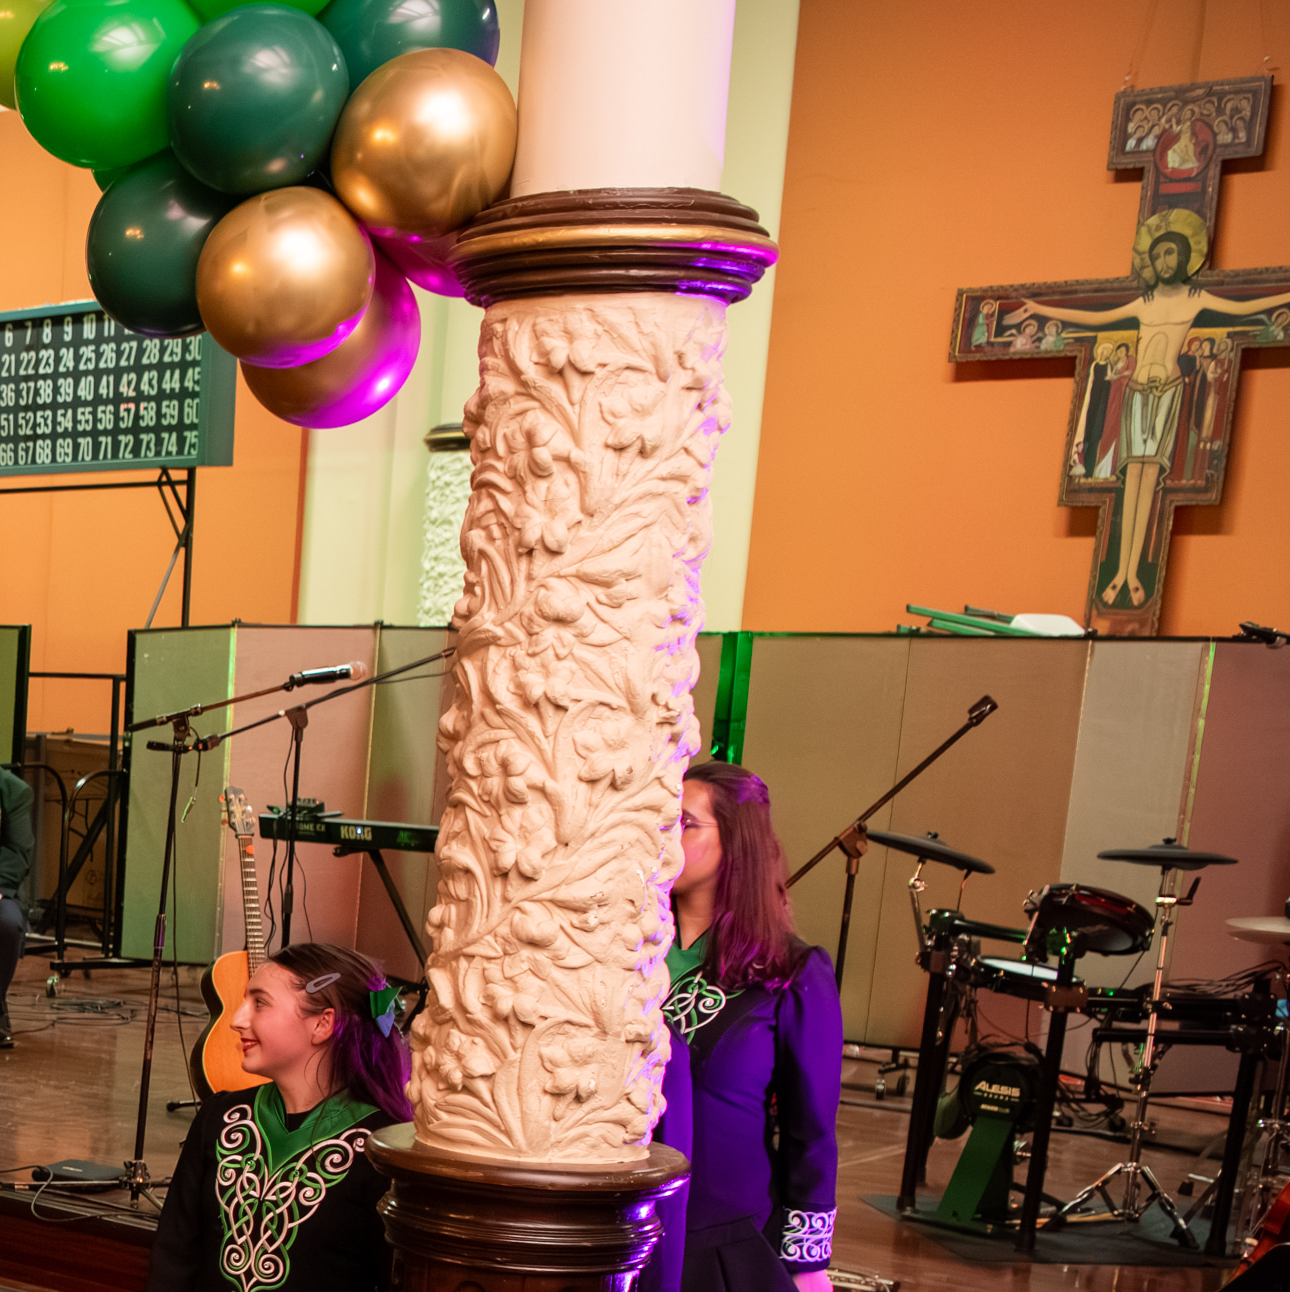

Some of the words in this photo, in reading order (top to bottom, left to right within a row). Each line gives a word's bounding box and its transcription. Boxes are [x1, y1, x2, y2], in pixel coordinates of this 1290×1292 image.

[5, 323, 13, 347] 6
[25, 321, 32, 345] 7
[43, 319, 51, 343] 8
[64, 317, 72, 341] 9
[83, 314, 96, 339] 10
[104, 314, 115, 337] 11
[1, 354, 15, 377] 21
[20, 351, 36, 375] 22
[38, 349, 54, 374] 23
[59, 348, 74, 372] 24
[79, 345, 95, 370] 25
[99, 342, 116, 368] 26
[120, 341, 137, 366] 27
[142, 339, 160, 364] 28
[163, 339, 181, 362] 29
[186, 336, 201, 361] 30
[0, 383, 15, 407] 36
[20, 382, 34, 406] 37
[37, 380, 52, 404] 38
[57, 378, 73, 402] 39
[77, 375, 94, 400] 40
[99, 375, 114, 399] 41
[119, 373, 136, 397] 42
[141, 371, 158, 395] 43
[162, 369, 180, 393] 44
[184, 367, 201, 391] 45
[1, 414, 13, 436] 51
[19, 412, 34, 435] 52
[36, 410, 52, 434] 53
[57, 409, 73, 433] 54
[77, 407, 92, 431] 55
[97, 405, 114, 430] 56
[120, 403, 135, 428] 57
[140, 402, 156, 427] 58
[161, 400, 178, 425] 59
[184, 398, 199, 424] 60
[0, 443, 14, 466] 66
[19, 441, 33, 465] 67
[36, 439, 51, 464] 68
[57, 439, 72, 462] 69
[77, 437, 92, 461] 70
[98, 436, 111, 460] 71
[118, 435, 134, 459] 72
[140, 433, 155, 458] 73
[161, 432, 177, 456] 74
[183, 431, 198, 455] 75
[340, 825, 373, 841] KORG
[975, 1080, 1020, 1097] ALESIS
